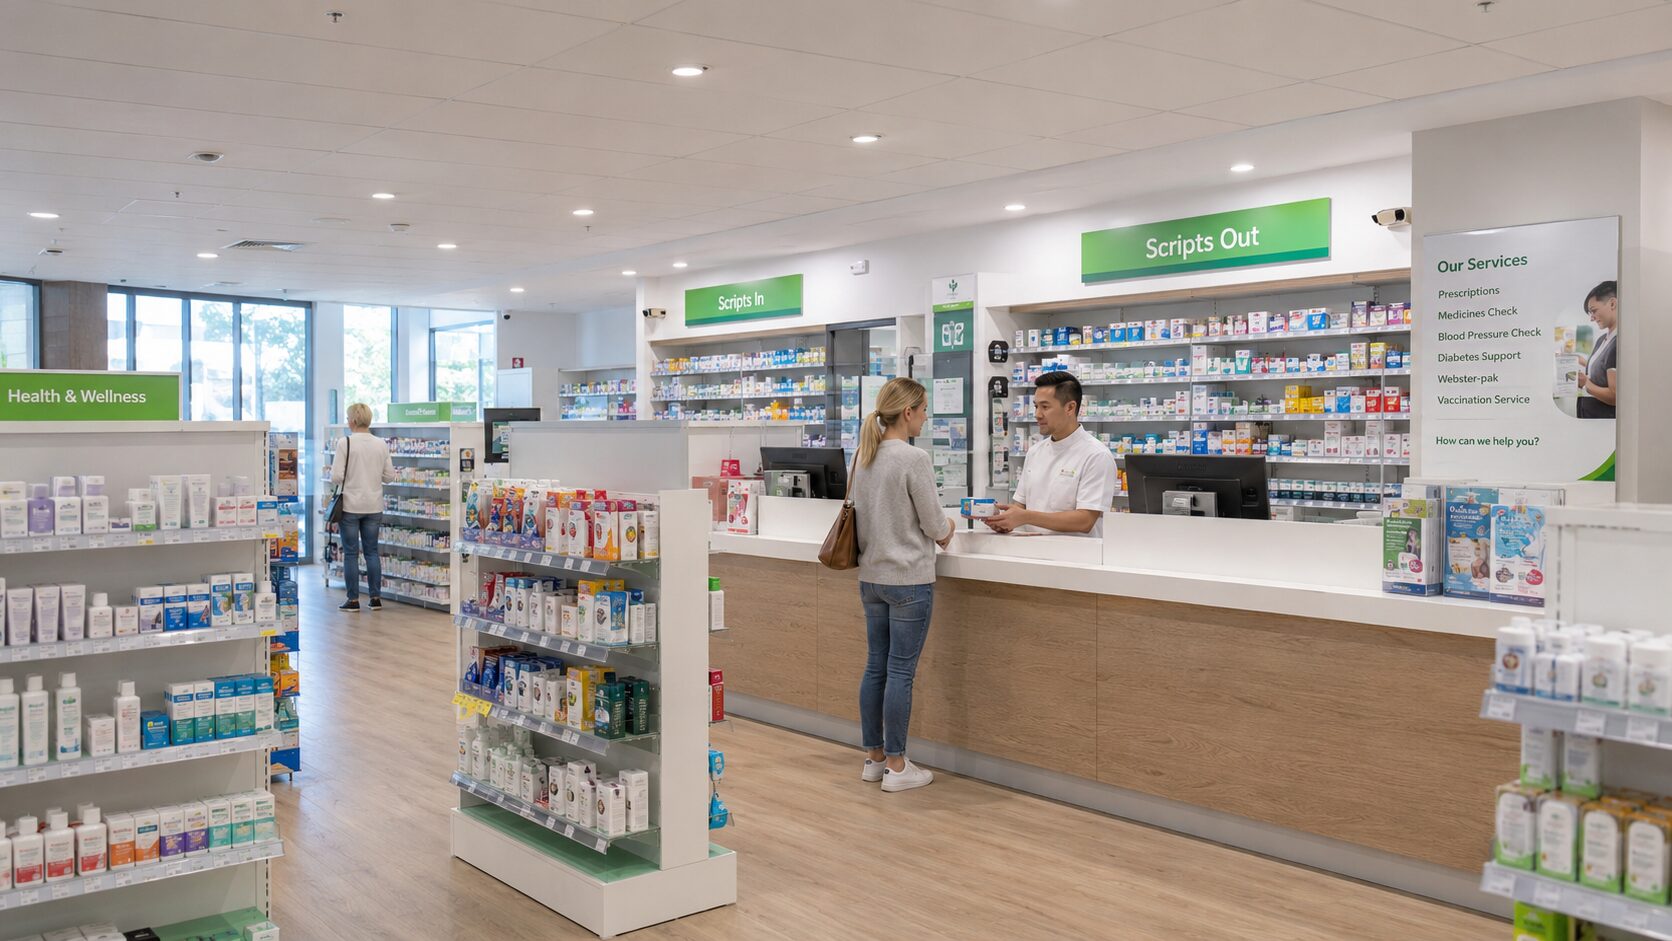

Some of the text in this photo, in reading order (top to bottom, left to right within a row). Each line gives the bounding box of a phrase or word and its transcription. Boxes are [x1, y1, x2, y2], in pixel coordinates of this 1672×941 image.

[1146, 226, 1259, 260] Scripts Out
[1437, 254, 1528, 273] Our Services
[1438, 286, 1500, 299] Prescriptions
[719, 292, 764, 312] Scripts In
[1438, 306, 1518, 320] Medicines Check
[1438, 327, 1542, 341] Blood Pressure Check
[1438, 351, 1522, 363] Diabetes Support
[1438, 373, 1499, 385] Webster-pak
[8, 389, 146, 403] Health & Wellness
[1437, 394, 1530, 405] Vaccination Service
[1436, 436, 1540, 448] How can we help you?
